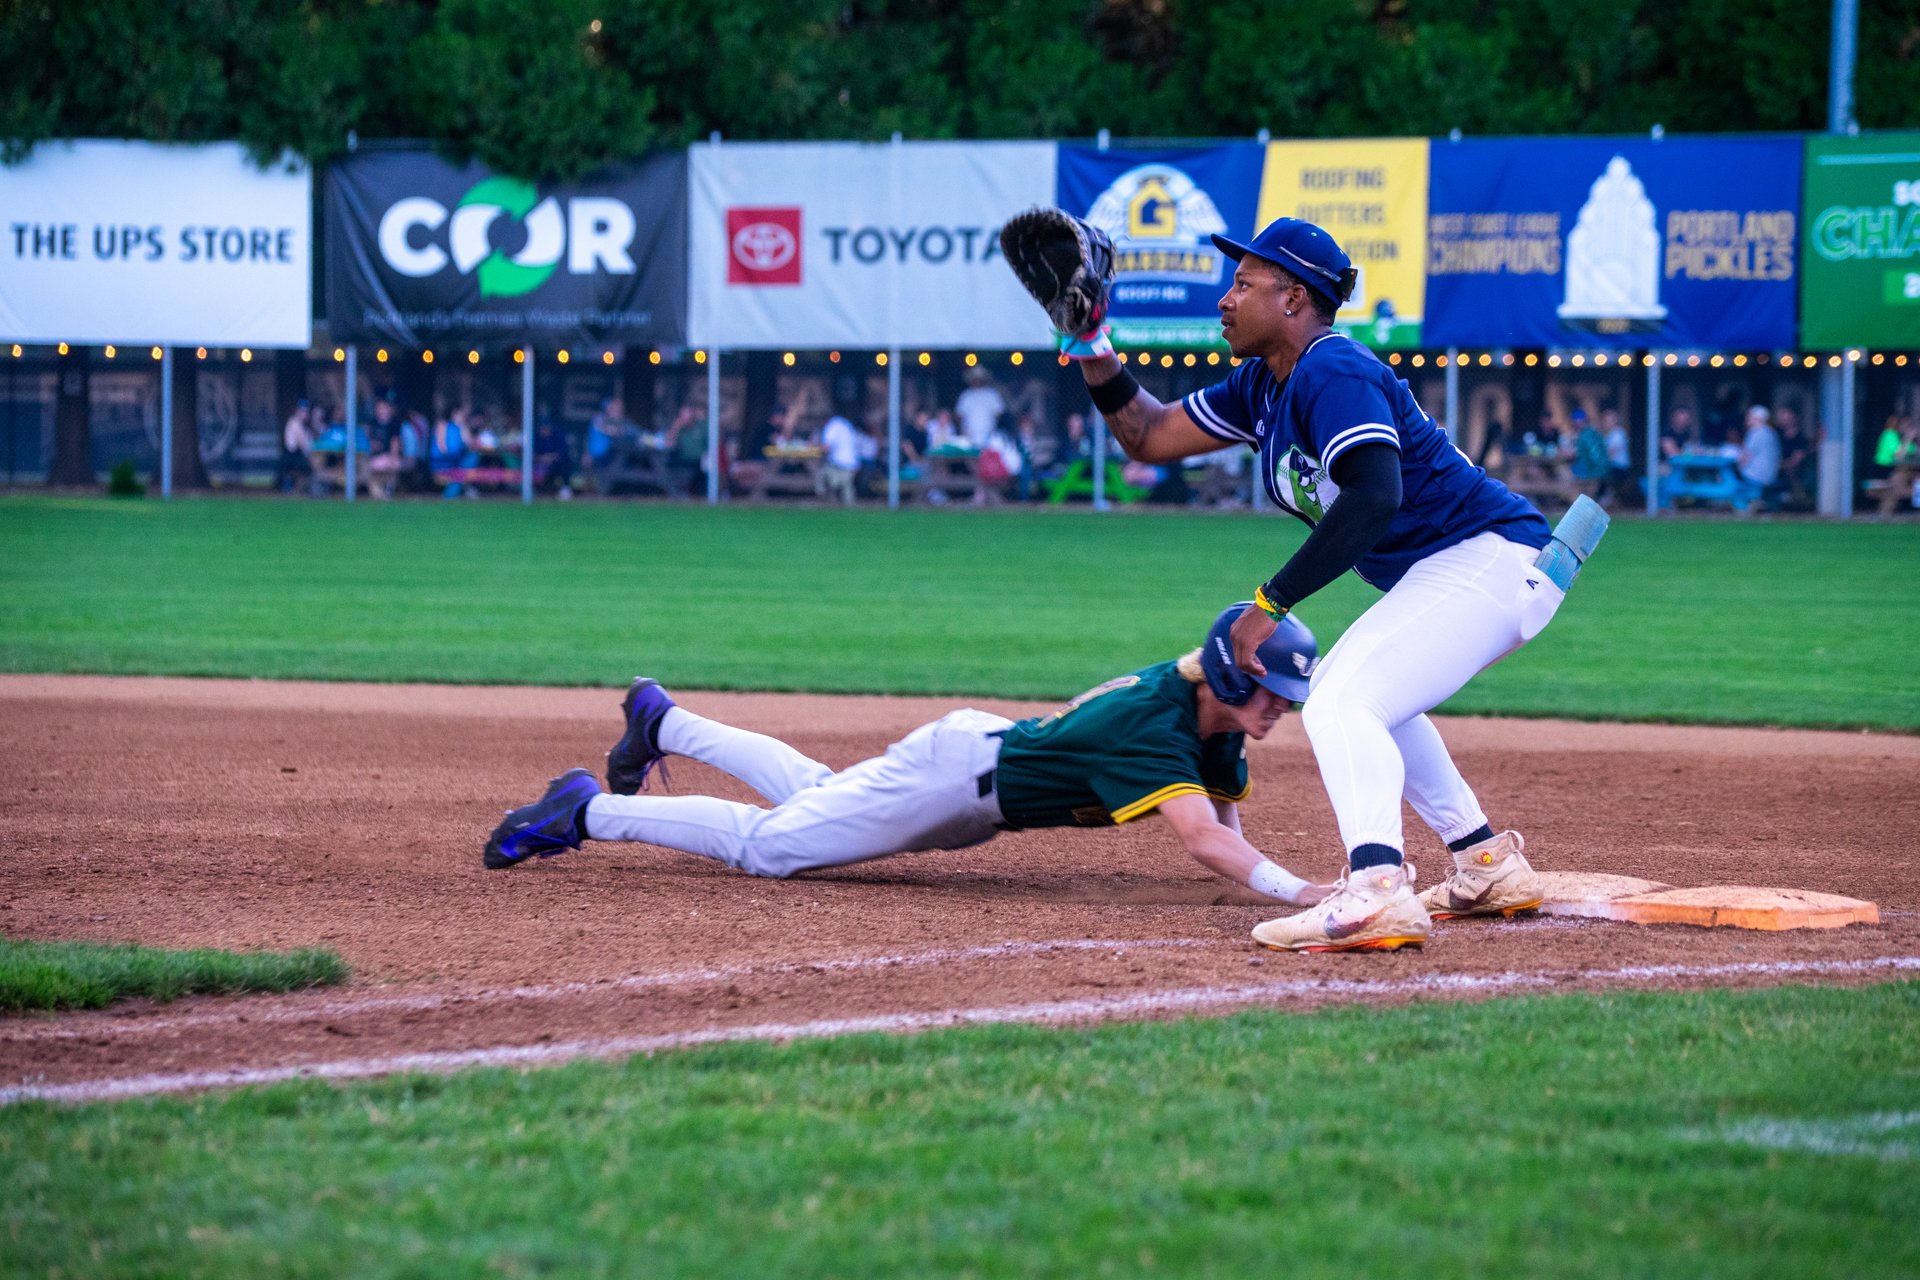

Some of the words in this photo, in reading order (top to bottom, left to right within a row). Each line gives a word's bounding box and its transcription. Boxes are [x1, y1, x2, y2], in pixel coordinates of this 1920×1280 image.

[1300, 167, 1386, 191] ROOFING
[10, 222, 77, 261] THE
[93, 223, 166, 262] UPS
[179, 225, 295, 263] STORE
[378, 177, 637, 299] COR
[821, 226, 1003, 264] TOYOTA
[1667, 210, 1795, 247] PORTLAND
[1427, 237, 1561, 276] CHAMPIONS
[1665, 242, 1793, 281] PICKLES
